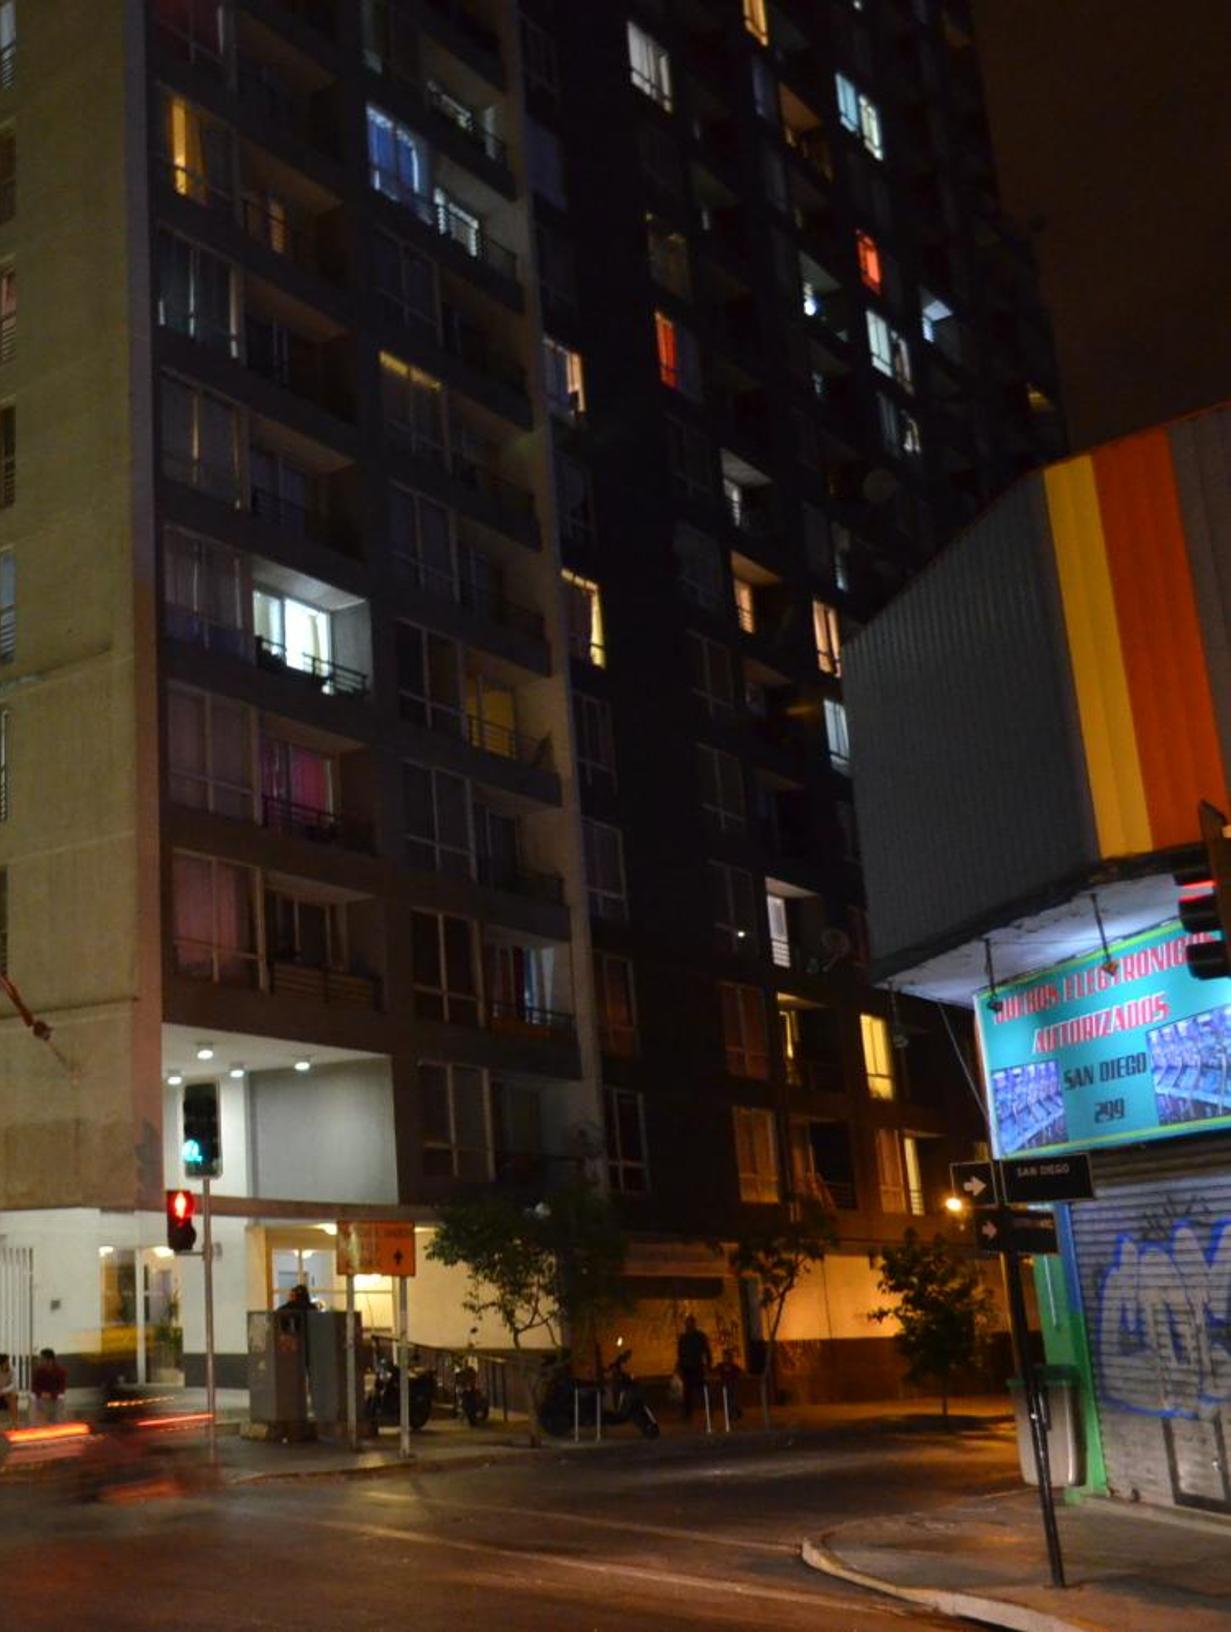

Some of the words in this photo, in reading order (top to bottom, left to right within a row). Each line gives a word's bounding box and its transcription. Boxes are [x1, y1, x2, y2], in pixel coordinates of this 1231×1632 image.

[1032, 991, 1171, 1055] AUTORIZADOS
[1063, 1065, 1094, 1091] SAN
[1099, 1052, 1147, 1082] DIEGO
[1016, 1166, 1038, 1177] SAN
[1039, 1163, 1071, 1176] DIEGO
